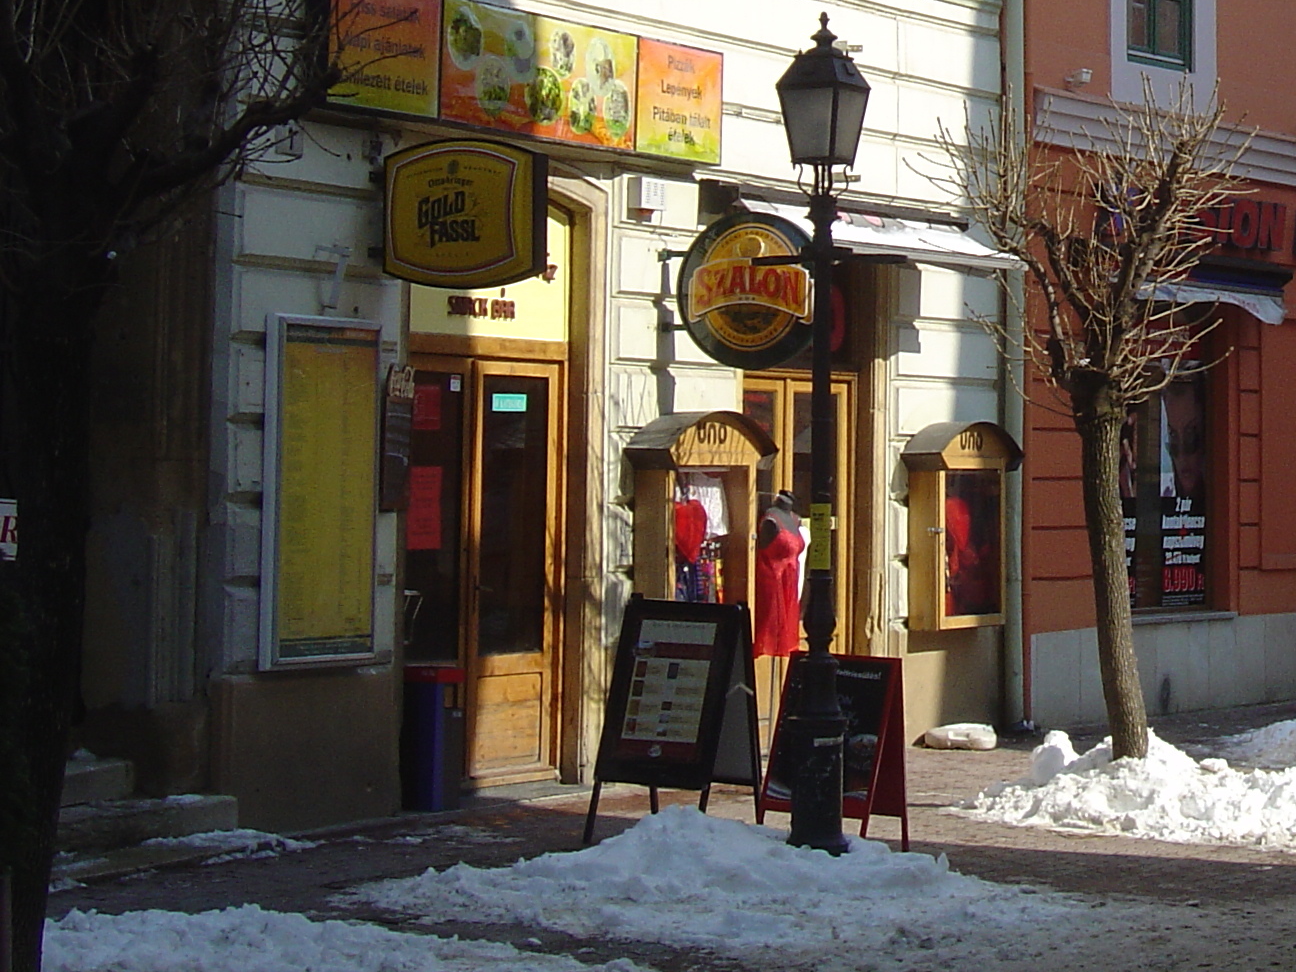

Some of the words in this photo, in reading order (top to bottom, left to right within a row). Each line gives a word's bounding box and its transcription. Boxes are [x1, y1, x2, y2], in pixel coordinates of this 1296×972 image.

[394, 75, 428, 96] ételek
[661, 78, 703, 101] Lepények
[417, 190, 466, 229] GOLD
[1173, 197, 1287, 252] SION
[429, 218, 480, 249] FASSL
[695, 265, 801, 307] SZALON
[447, 295, 488, 317] SNACK
